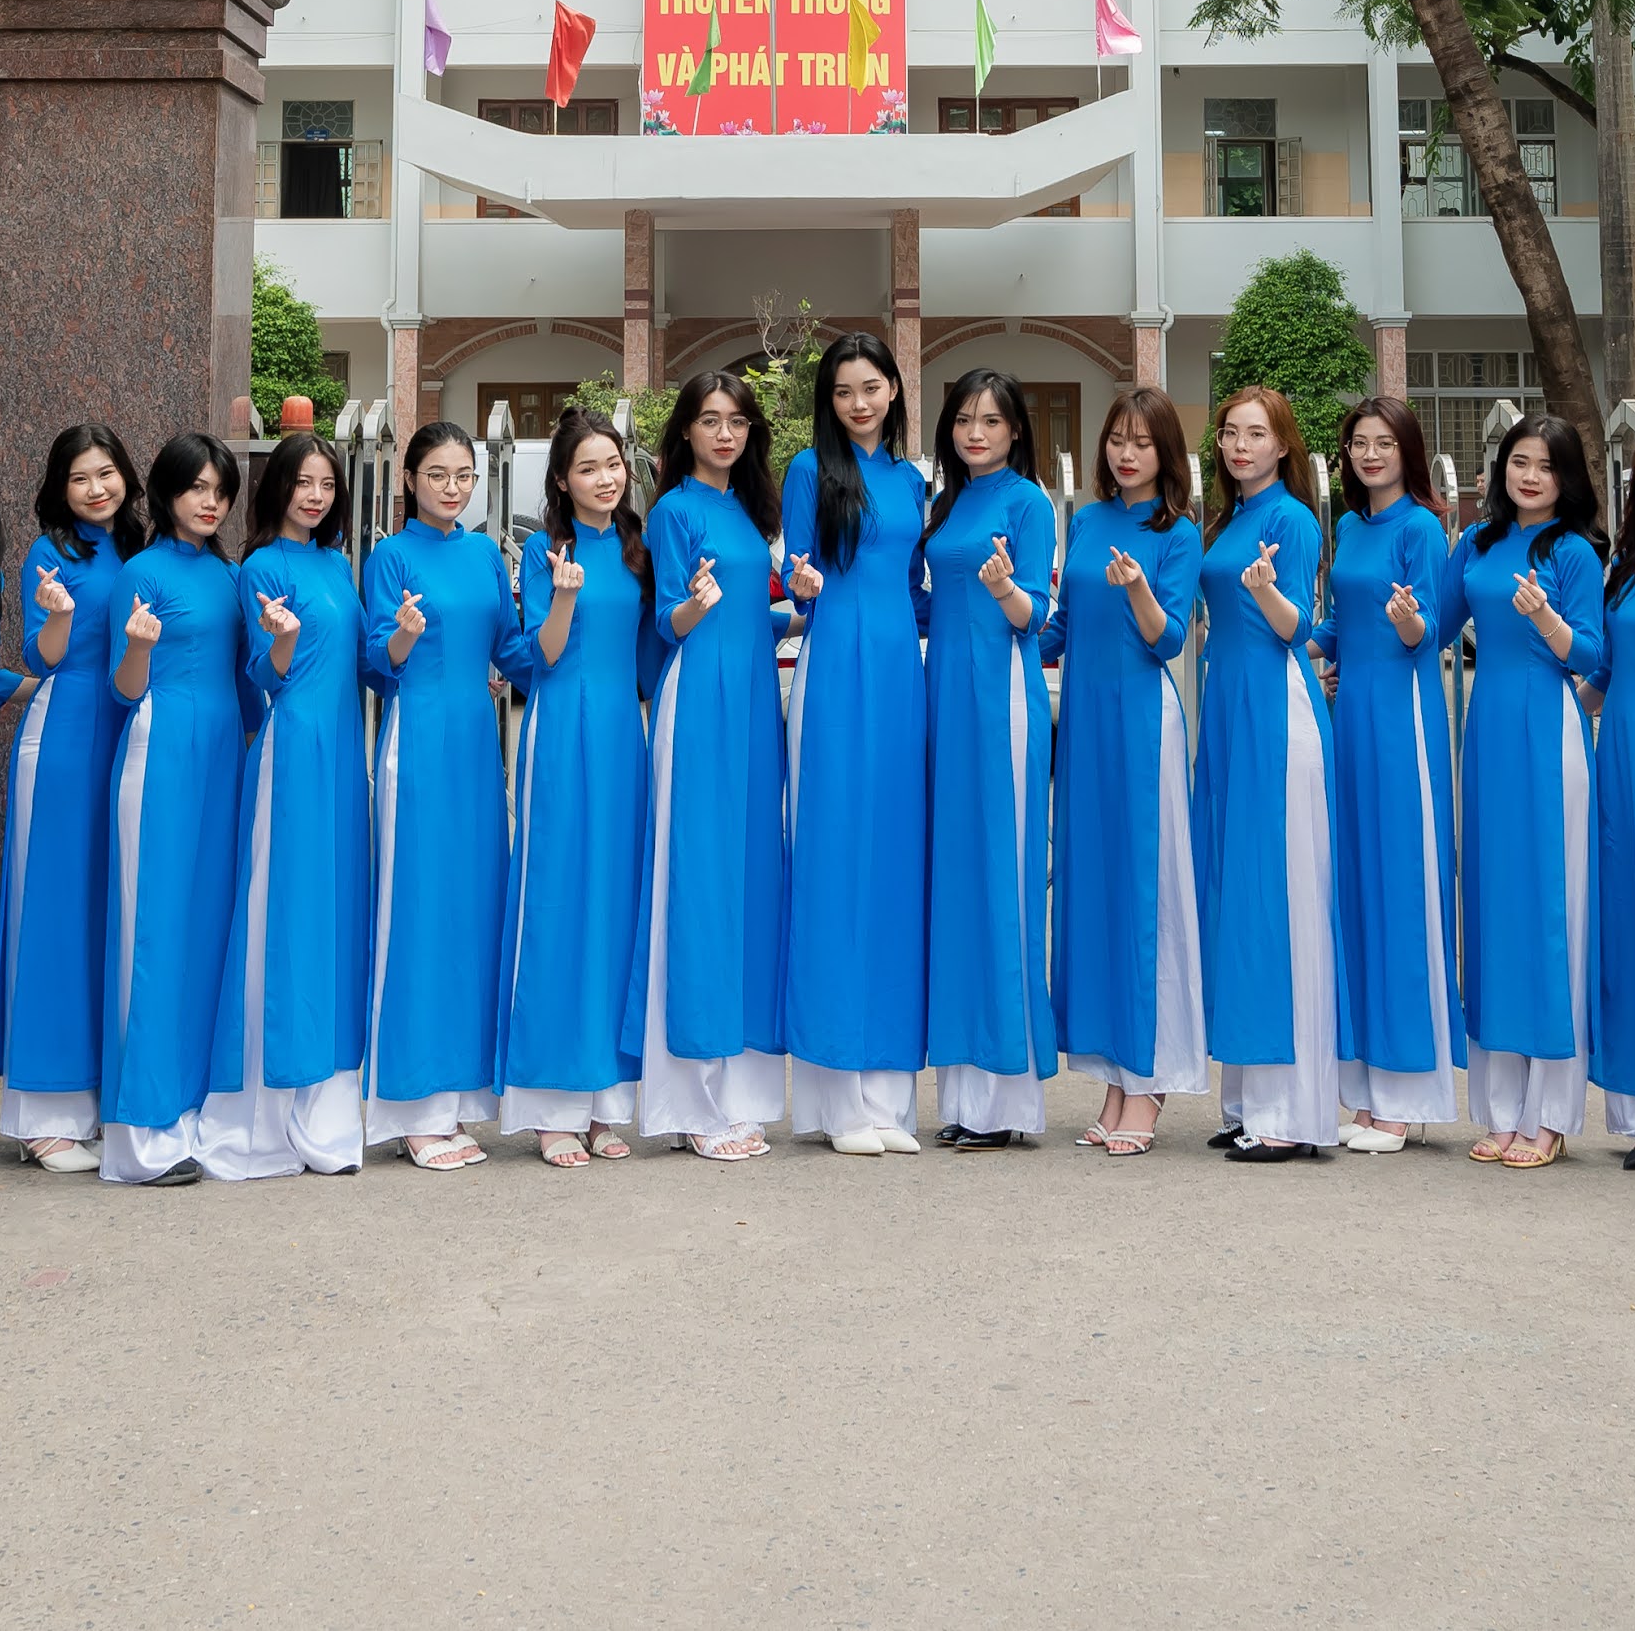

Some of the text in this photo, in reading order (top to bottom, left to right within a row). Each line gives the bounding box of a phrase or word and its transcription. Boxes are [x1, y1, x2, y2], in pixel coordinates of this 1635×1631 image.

[657, 45, 890, 87] VÀ PHÁT TRIN
